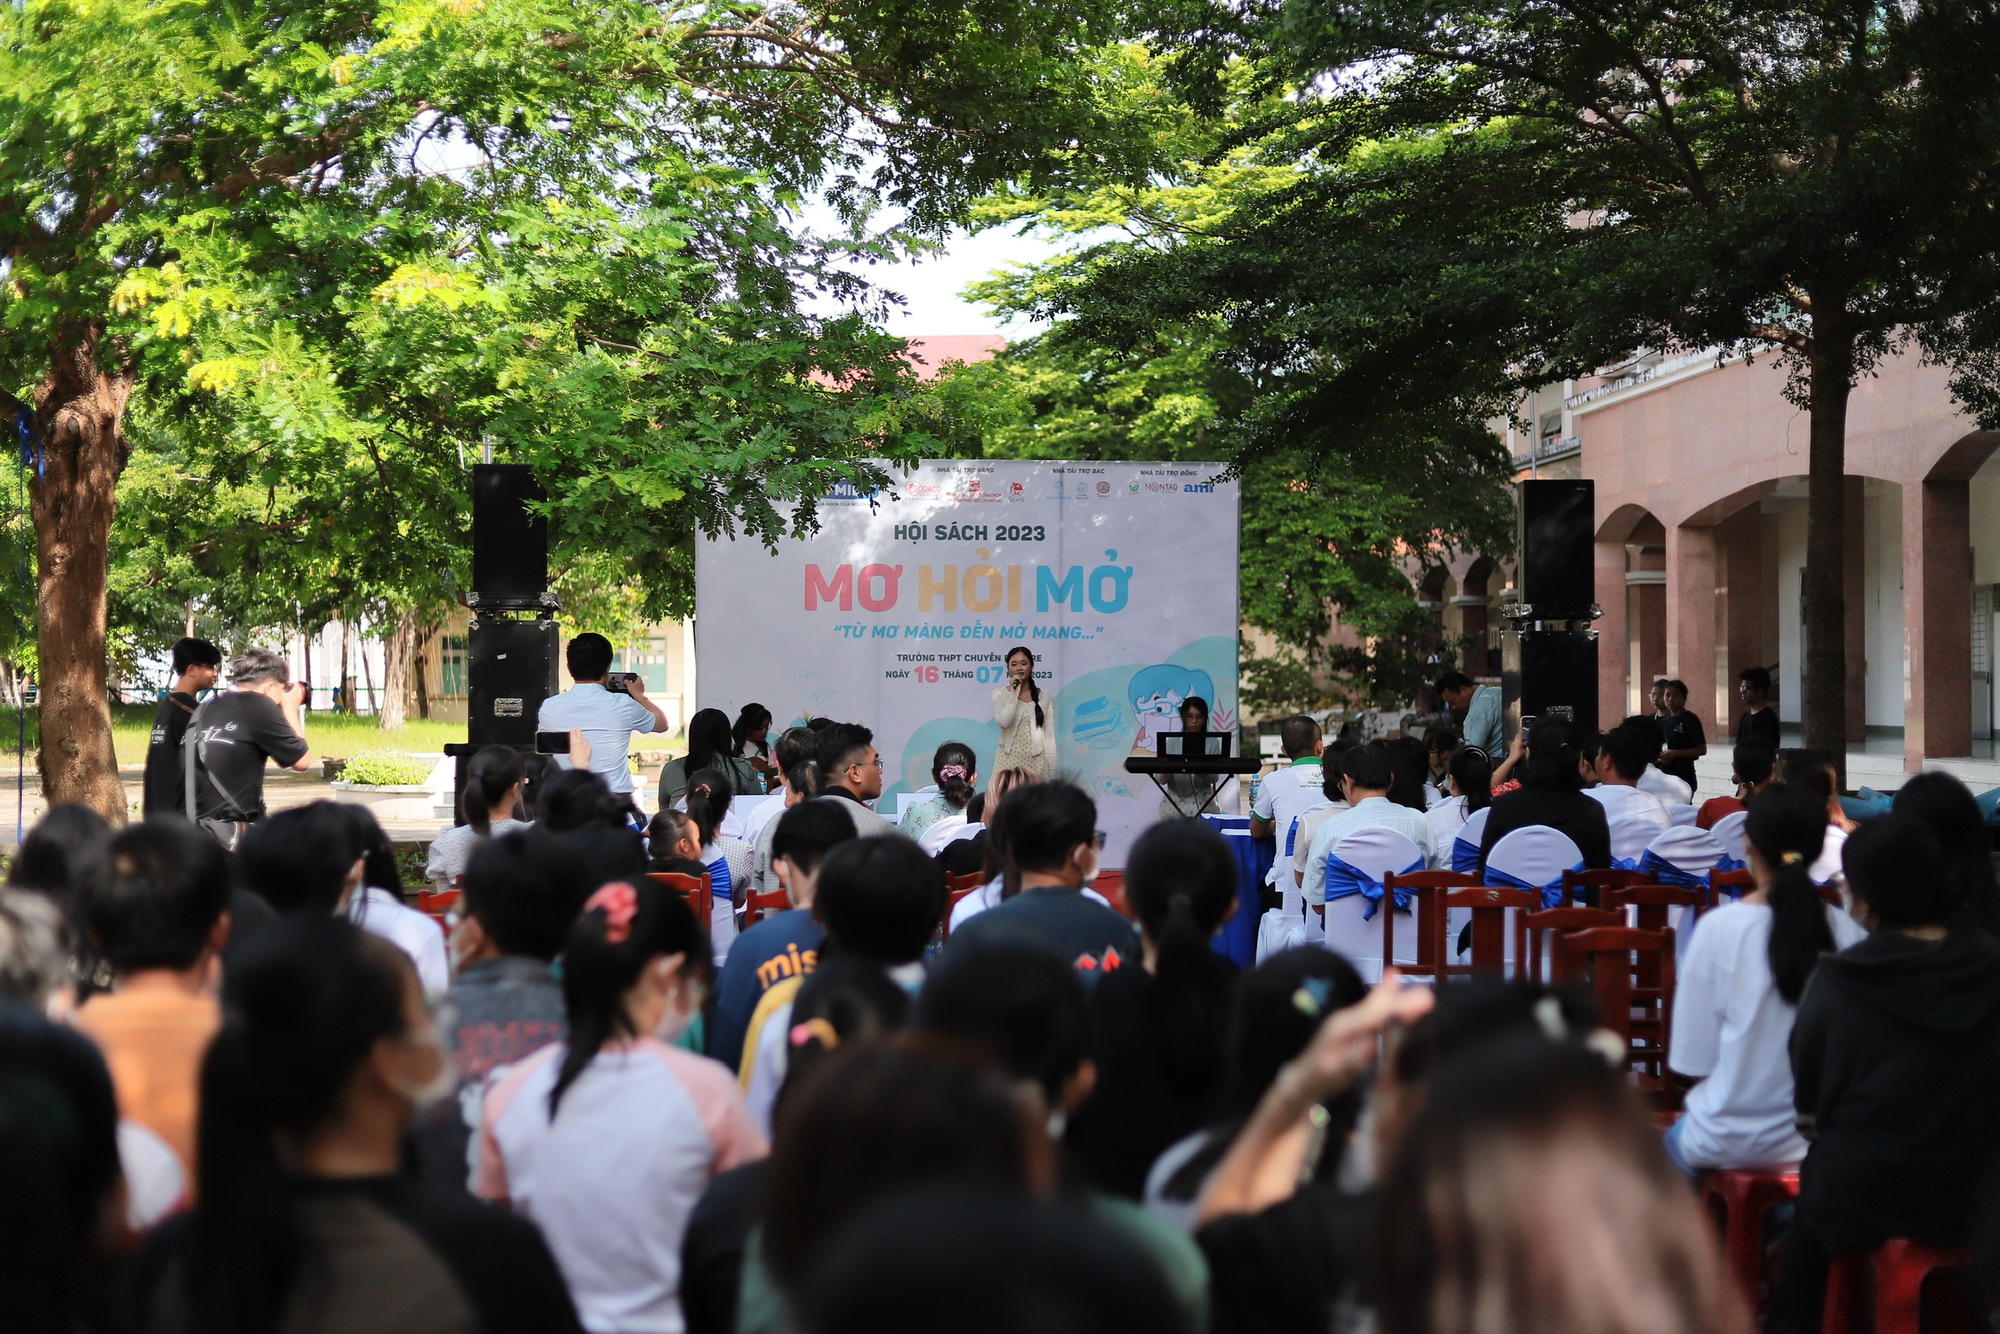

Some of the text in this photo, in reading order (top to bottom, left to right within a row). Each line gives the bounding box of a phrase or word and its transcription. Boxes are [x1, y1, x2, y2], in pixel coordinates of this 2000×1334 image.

[894, 521, 1046, 545] HỘI SÁCH 2023
[804, 547, 1134, 614] MƠ HỎI MỞ
[871, 624, 900, 639] MƠ
[960, 619, 997, 639] ĐẾN
[897, 651, 935, 662] TRƯỜNG
[938, 654, 962, 662] THPT
[964, 651, 1001, 662] CHUYÊN
[885, 669, 910, 679] NGÀY
[914, 665, 940, 683] 16
[943, 668, 974, 679] THÁNG
[976, 666, 1004, 684] 07
[1031, 671, 1053, 679] 2023
